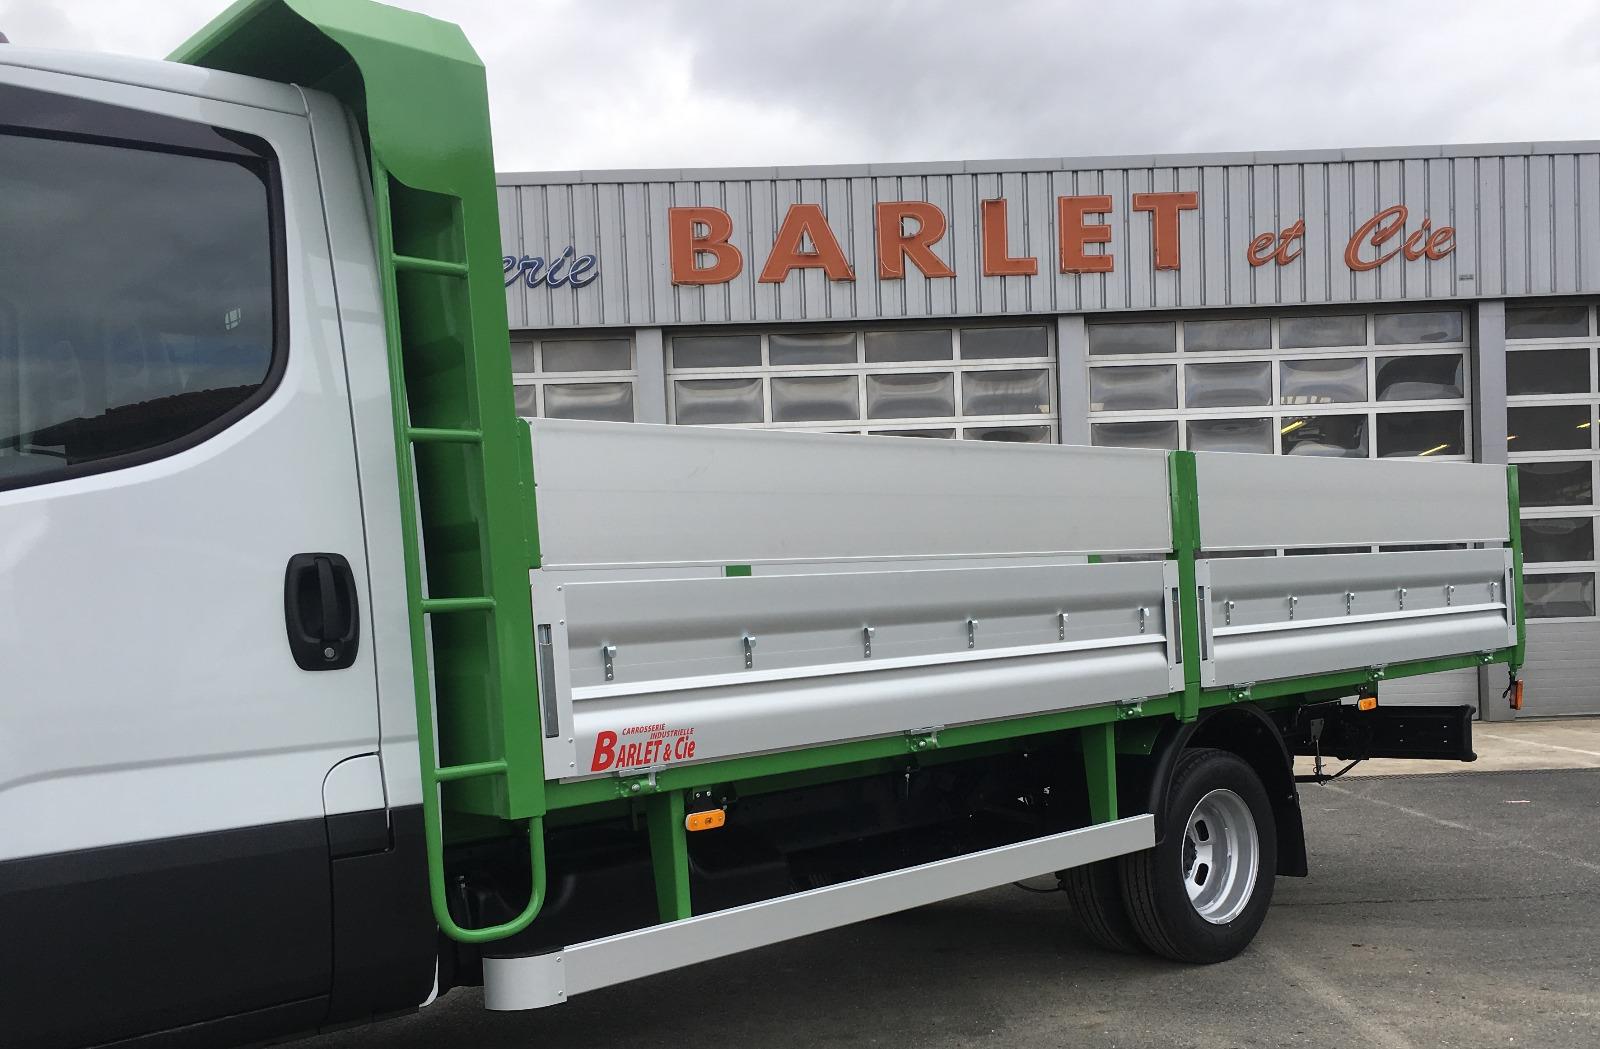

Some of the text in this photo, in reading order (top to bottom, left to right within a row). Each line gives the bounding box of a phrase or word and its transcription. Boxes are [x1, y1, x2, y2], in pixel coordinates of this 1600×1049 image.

[668, 190, 1199, 286] BARLET
[1247, 218, 1306, 267] et
[1344, 204, 1456, 272] Cie
[622, 723, 666, 736] CARROSSERIE
[650, 727, 695, 740] INDUSTRIELLE
[591, 730, 696, 772] BARLET & Cie
